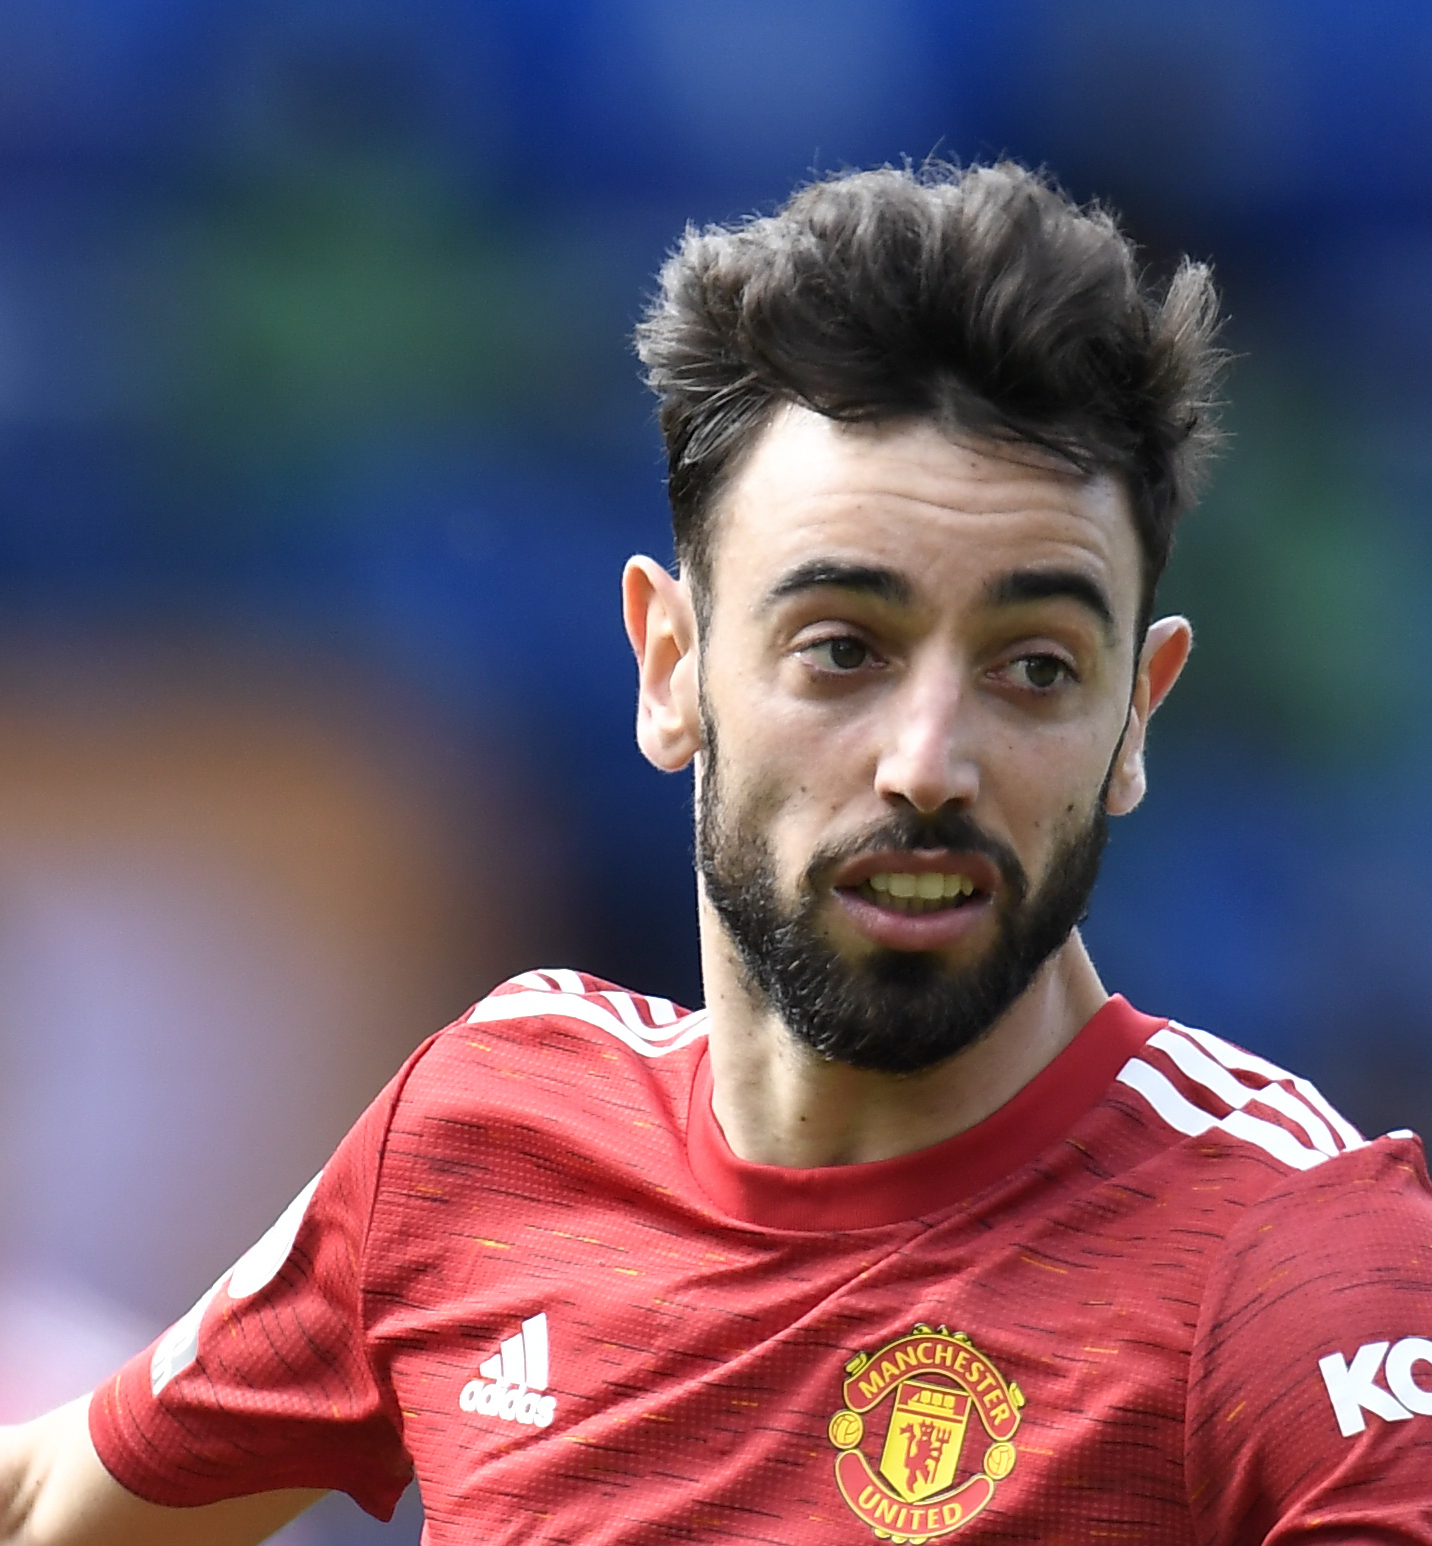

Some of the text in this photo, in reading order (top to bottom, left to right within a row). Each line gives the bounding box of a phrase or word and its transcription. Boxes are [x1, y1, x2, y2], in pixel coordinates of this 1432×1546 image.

[459, 1379, 557, 1428] adidas
[858, 1342, 1010, 1427] MANCHESTER
[859, 1486, 962, 1530] UNITED
